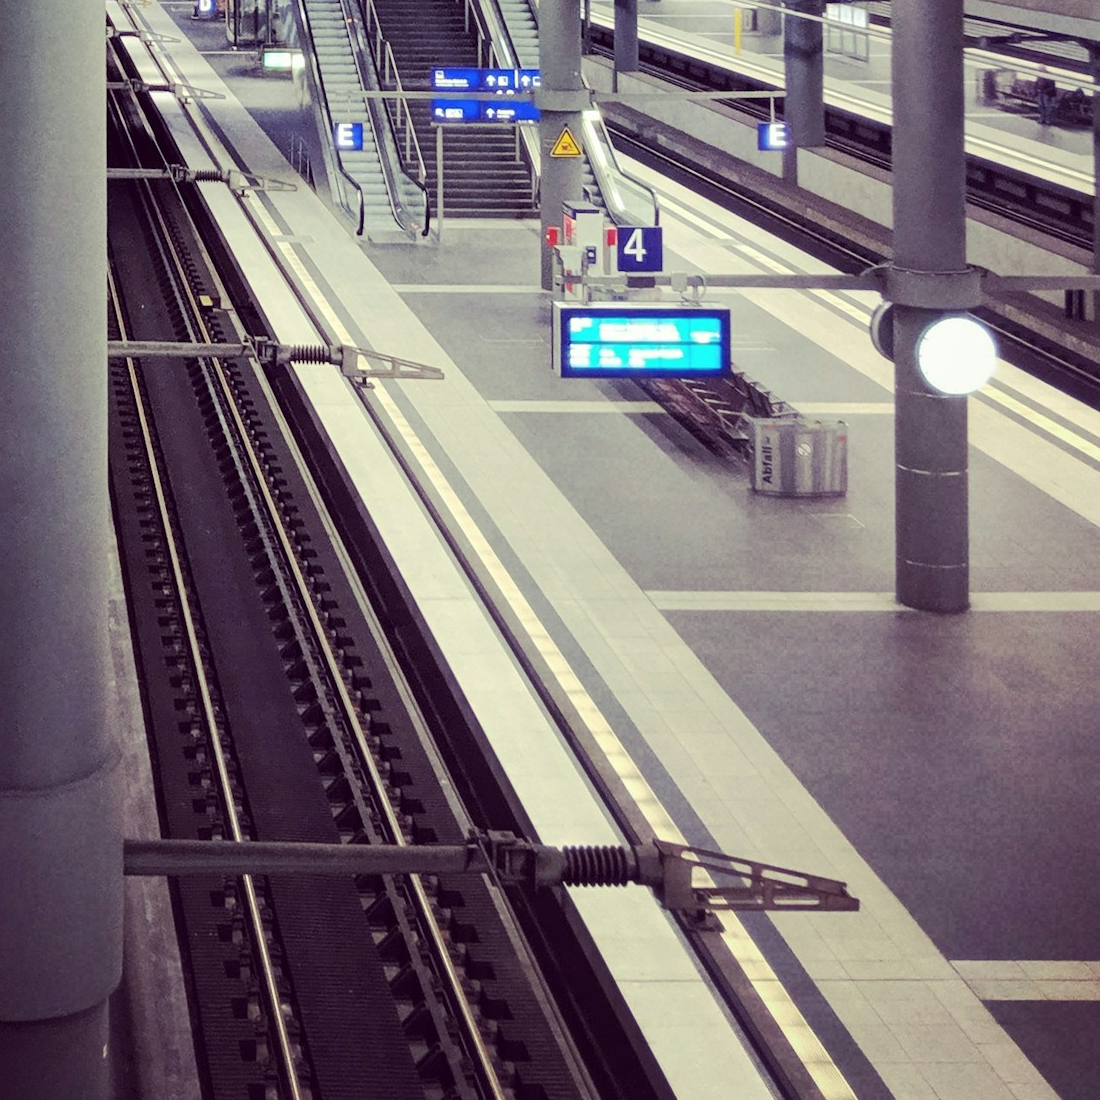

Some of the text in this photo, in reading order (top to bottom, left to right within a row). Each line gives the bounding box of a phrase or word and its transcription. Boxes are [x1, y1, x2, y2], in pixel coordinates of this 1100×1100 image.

[338, 123, 354, 146] E
[770, 124, 786, 146] E
[624, 229, 647, 262] 4
[762, 446, 772, 484] Abfall
